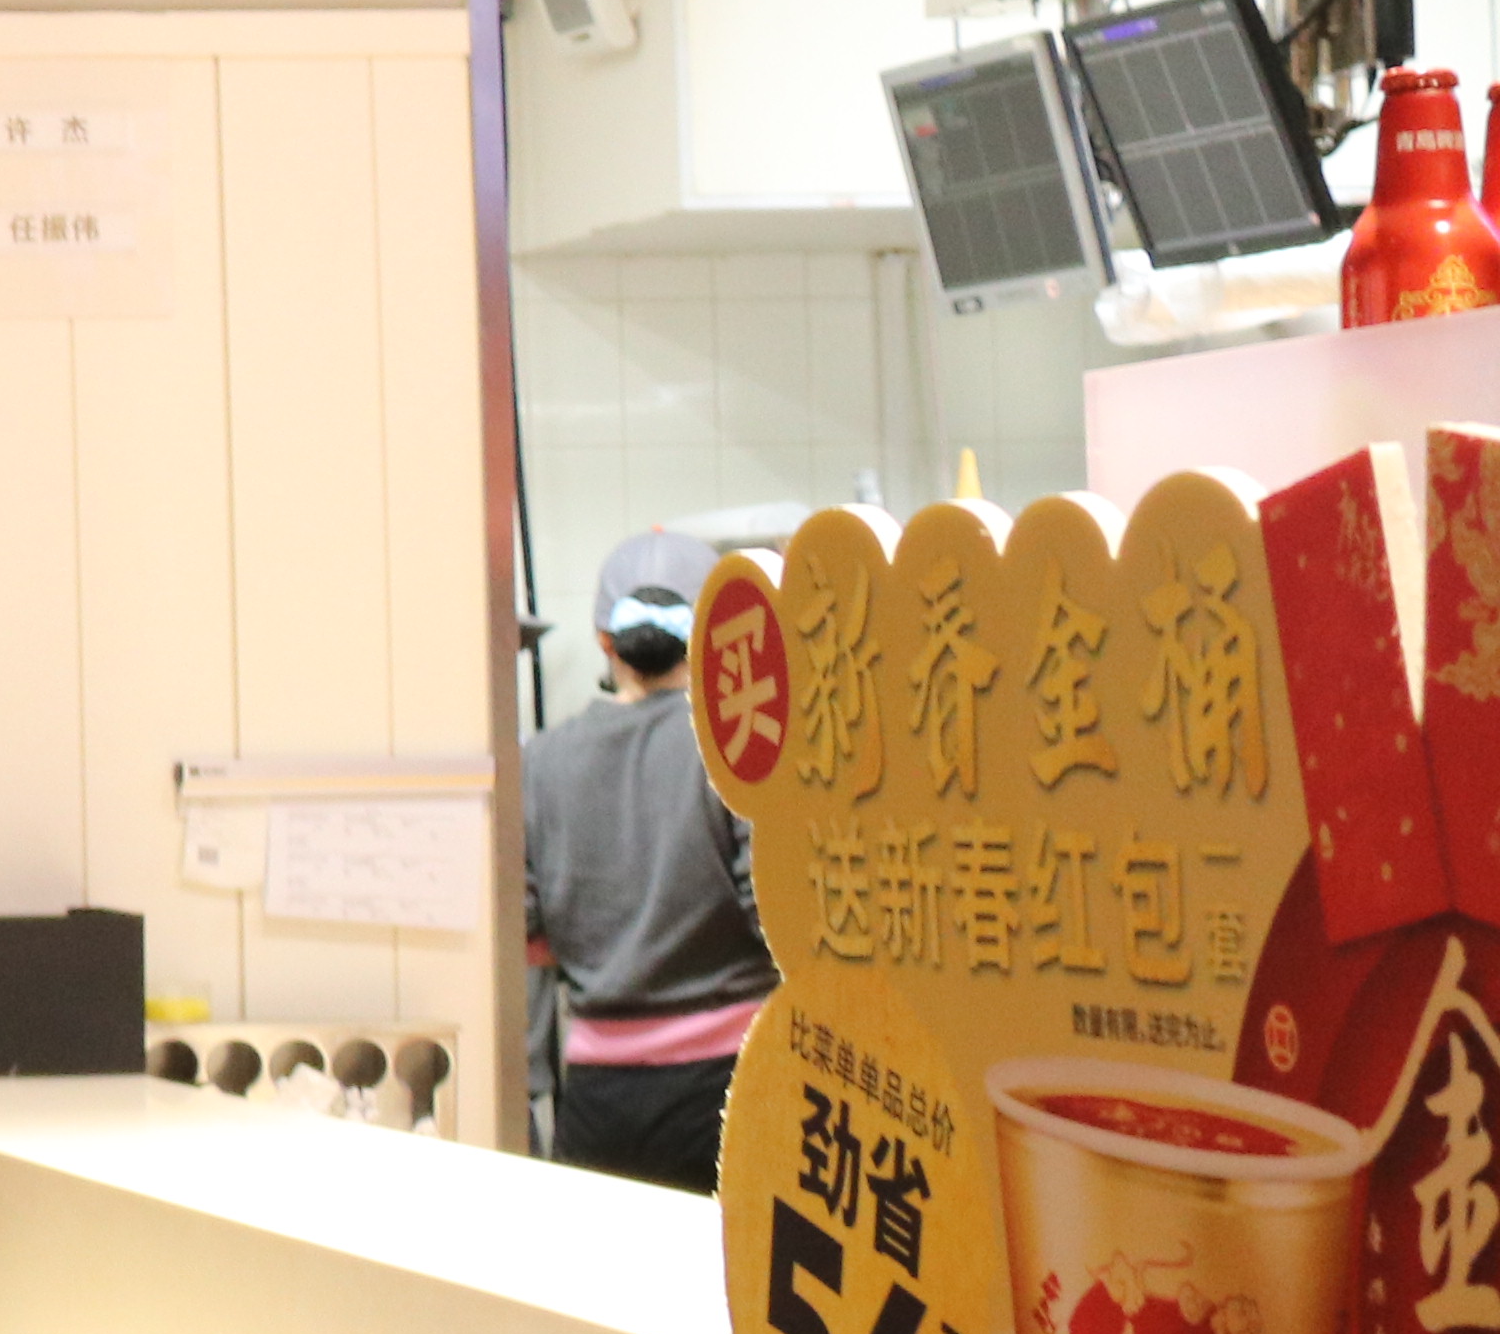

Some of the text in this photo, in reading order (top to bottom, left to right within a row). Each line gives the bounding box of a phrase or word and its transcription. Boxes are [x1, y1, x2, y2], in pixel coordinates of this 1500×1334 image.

[709, 605, 783, 767] 买
[790, 1006, 955, 1157] 比菜单单品总价
[798, 1081, 932, 1280] 劲省
